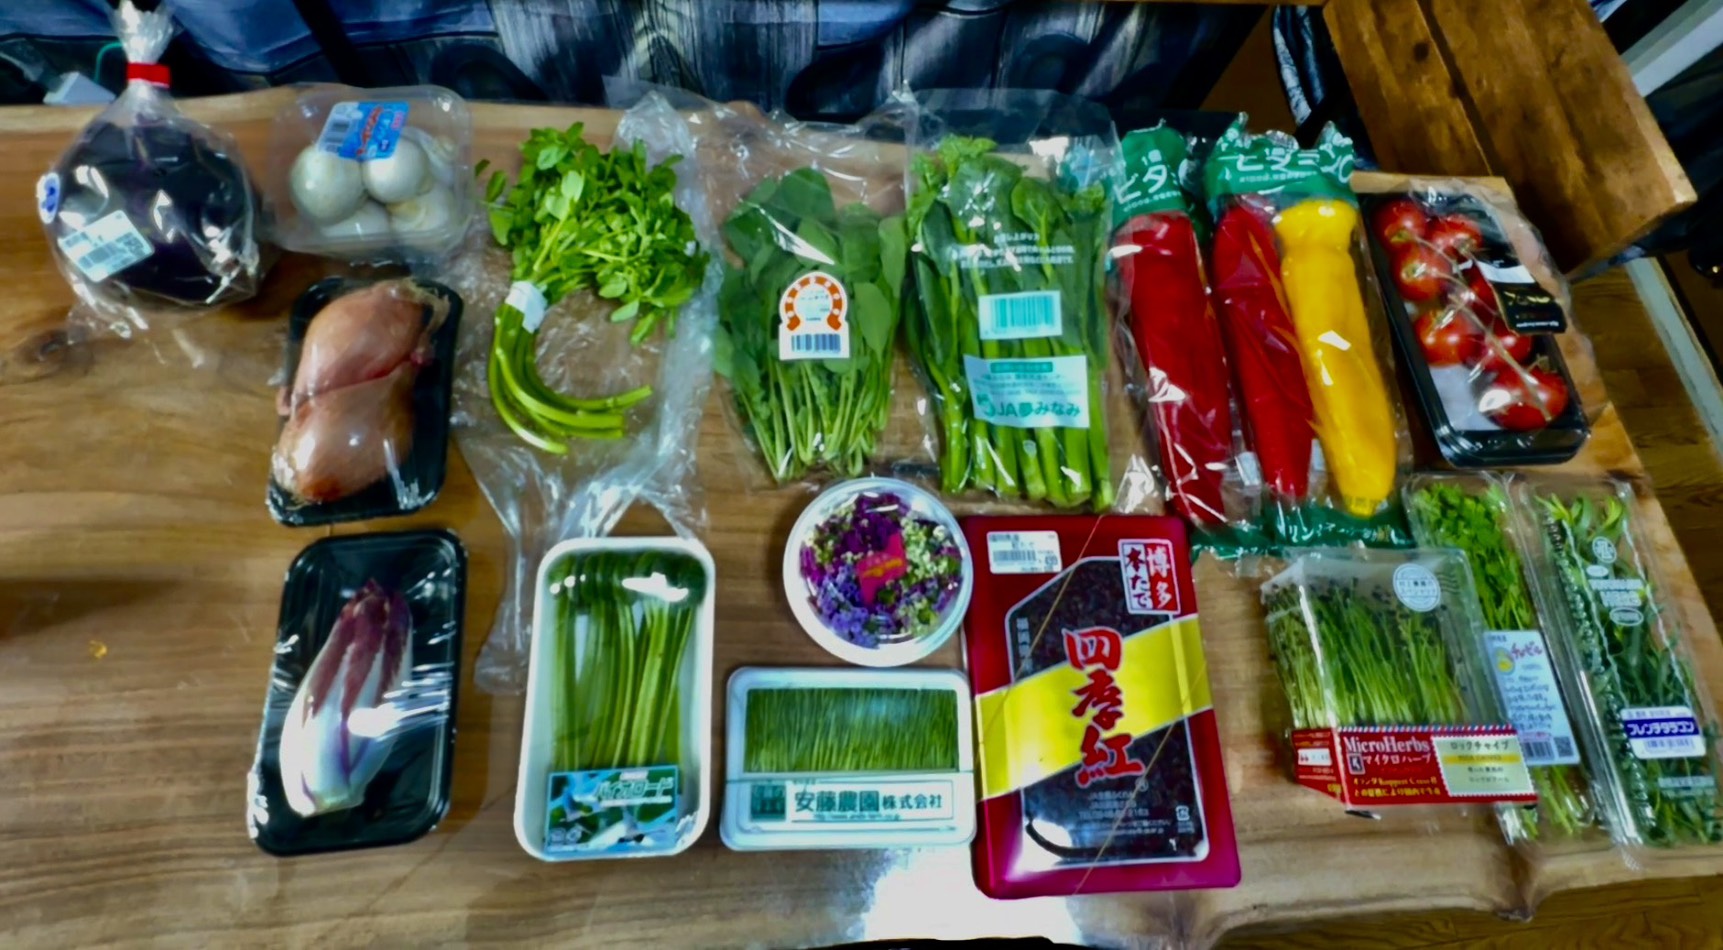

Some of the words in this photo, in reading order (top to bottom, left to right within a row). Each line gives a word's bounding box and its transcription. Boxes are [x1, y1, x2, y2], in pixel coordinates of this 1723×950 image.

[1343, 735, 1430, 752] MicroHerbs
[1450, 740, 1509, 750] ロックチャイブ
[1363, 753, 1431, 765] マイクロハーブ
